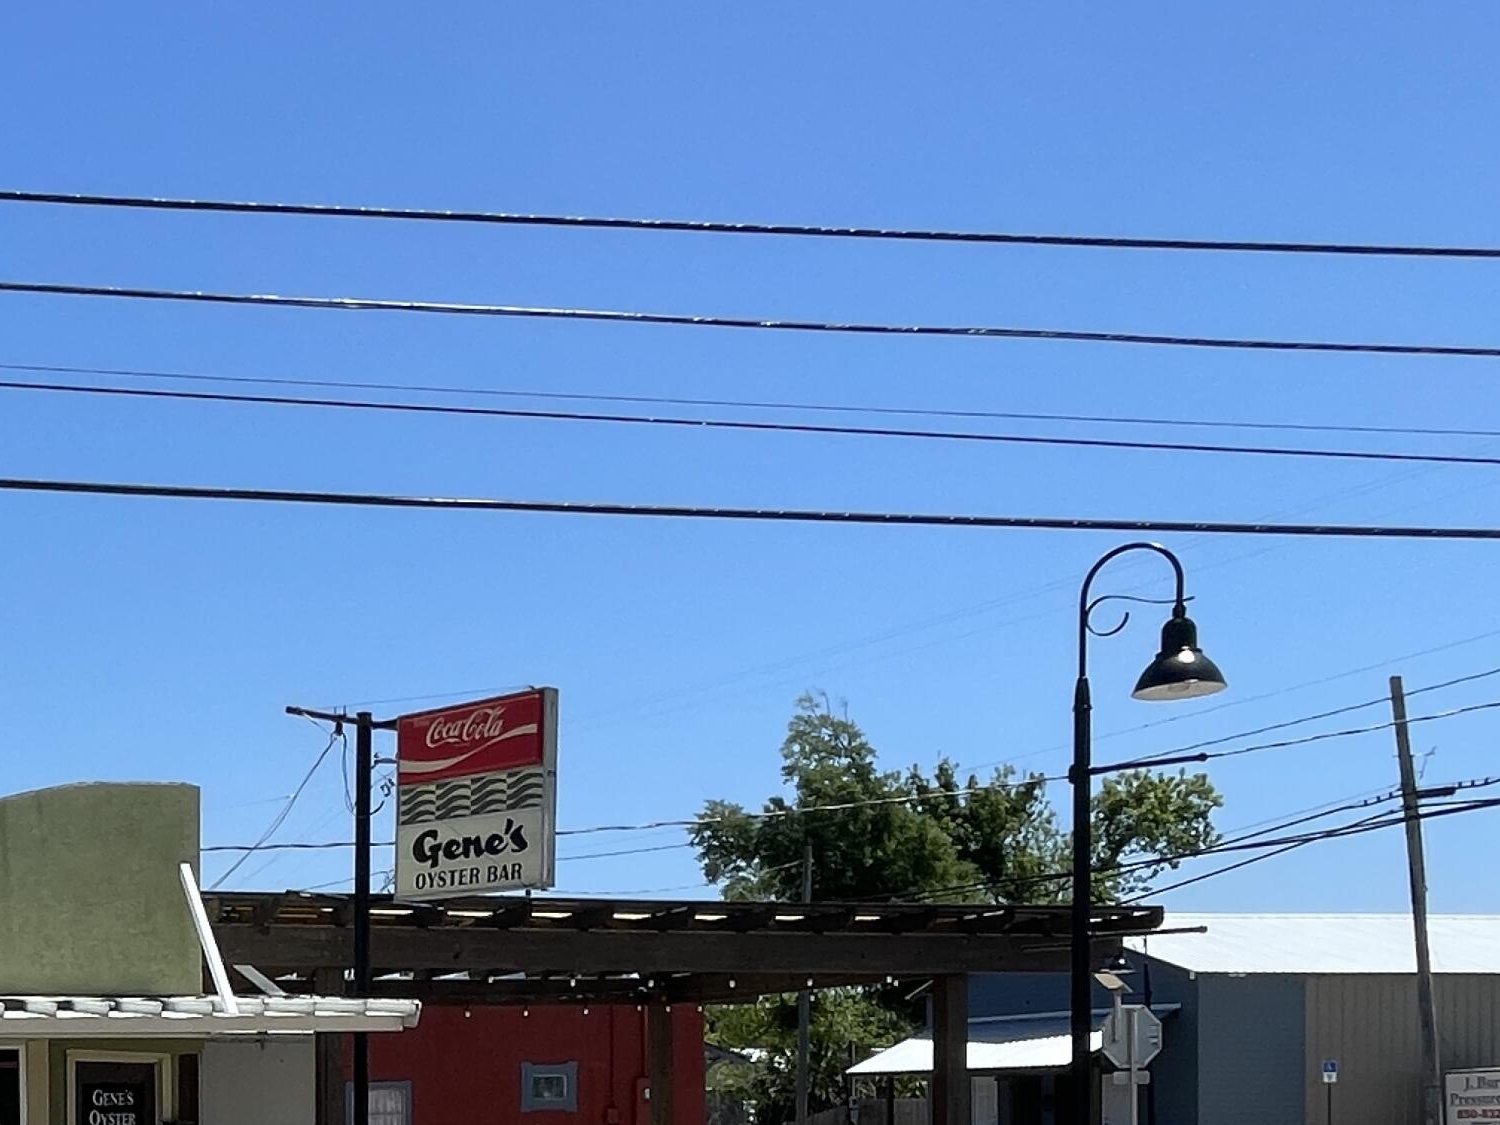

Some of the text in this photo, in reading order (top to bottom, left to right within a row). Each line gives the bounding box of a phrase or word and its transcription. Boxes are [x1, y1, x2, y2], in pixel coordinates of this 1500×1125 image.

[412, 818, 528, 869] Gene's
[415, 863, 522, 890] OYSTER BAR
[92, 1089, 134, 1106] GENE'S
